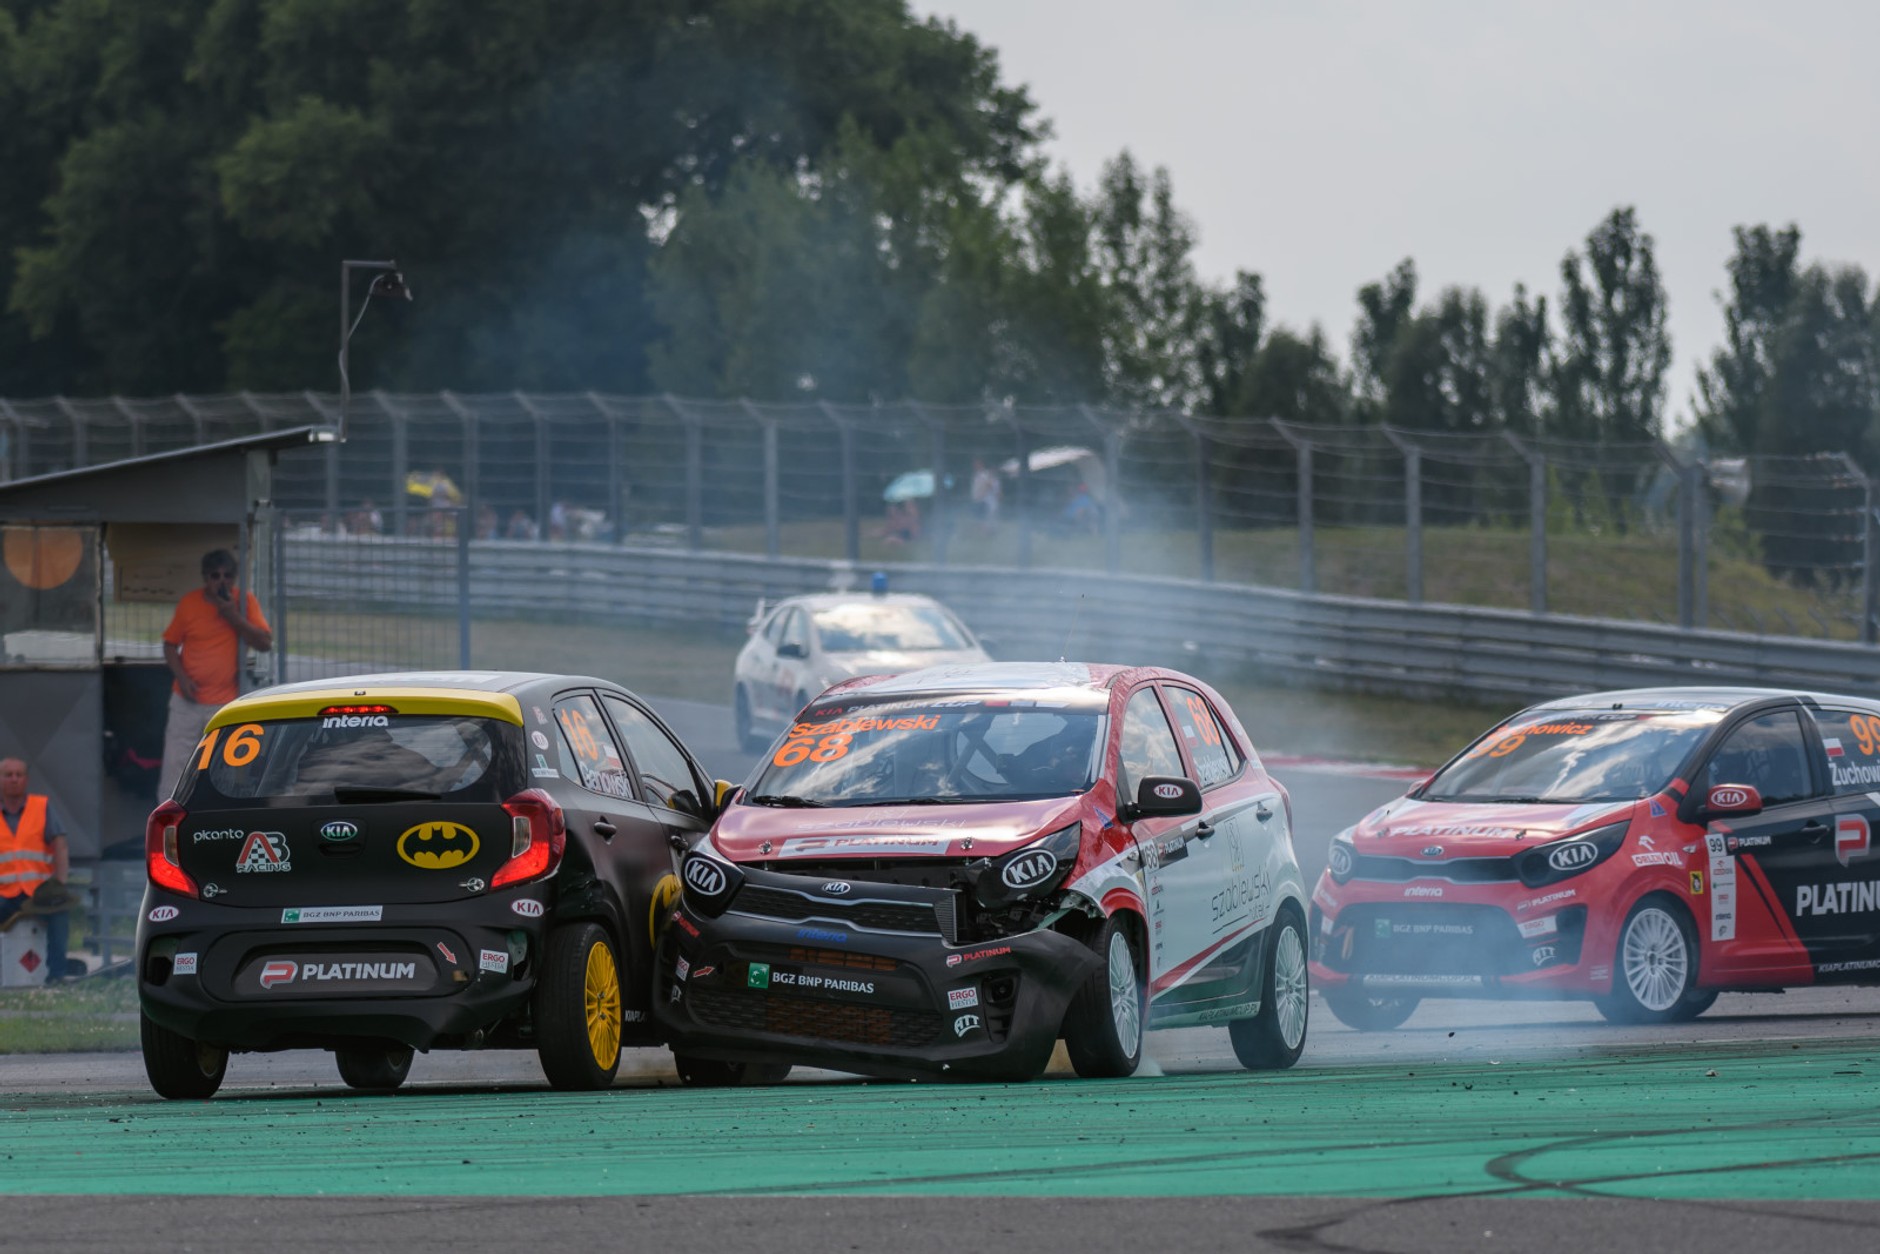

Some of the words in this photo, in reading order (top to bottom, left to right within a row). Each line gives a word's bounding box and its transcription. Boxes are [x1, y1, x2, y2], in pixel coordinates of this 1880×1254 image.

[815, 708, 843, 716] KIA
[847, 701, 927, 713] PLATINUM
[929, 700, 983, 708] CUP
[322, 714, 389, 729] interia
[788, 714, 941, 738] Szablewski
[1187, 696, 1220, 746] 68
[561, 708, 599, 761] 16
[198, 723, 265, 770] 16
[773, 733, 853, 767] 68
[193, 828, 245, 844] picanto
[1388, 826, 1516, 838] PLATINUM
[834, 838, 938, 847] PLATINUM
[1709, 838, 1723, 852] 99
[1739, 836, 1771, 848] PLATINUM
[1557, 846, 1592, 867] KIA
[1663, 852, 1682, 865] OIL
[236, 862, 292, 873] RACING
[1009, 855, 1051, 883] KIA
[1404, 885, 1443, 897] interia
[1532, 889, 1576, 906] PLATINUM
[343, 909, 380, 917] PARIBAS
[1434, 925, 1473, 934] PARIBAS
[177, 957, 194, 965] ERGO
[483, 952, 505, 963] ERGO
[963, 947, 1011, 961] PLATINUM
[302, 963, 415, 980] PLATINUM
[772, 971, 796, 984] BGZ
[798, 975, 822, 988] BNP
[824, 978, 874, 994] PARIBAS
[949, 989, 975, 1001] ERGO
